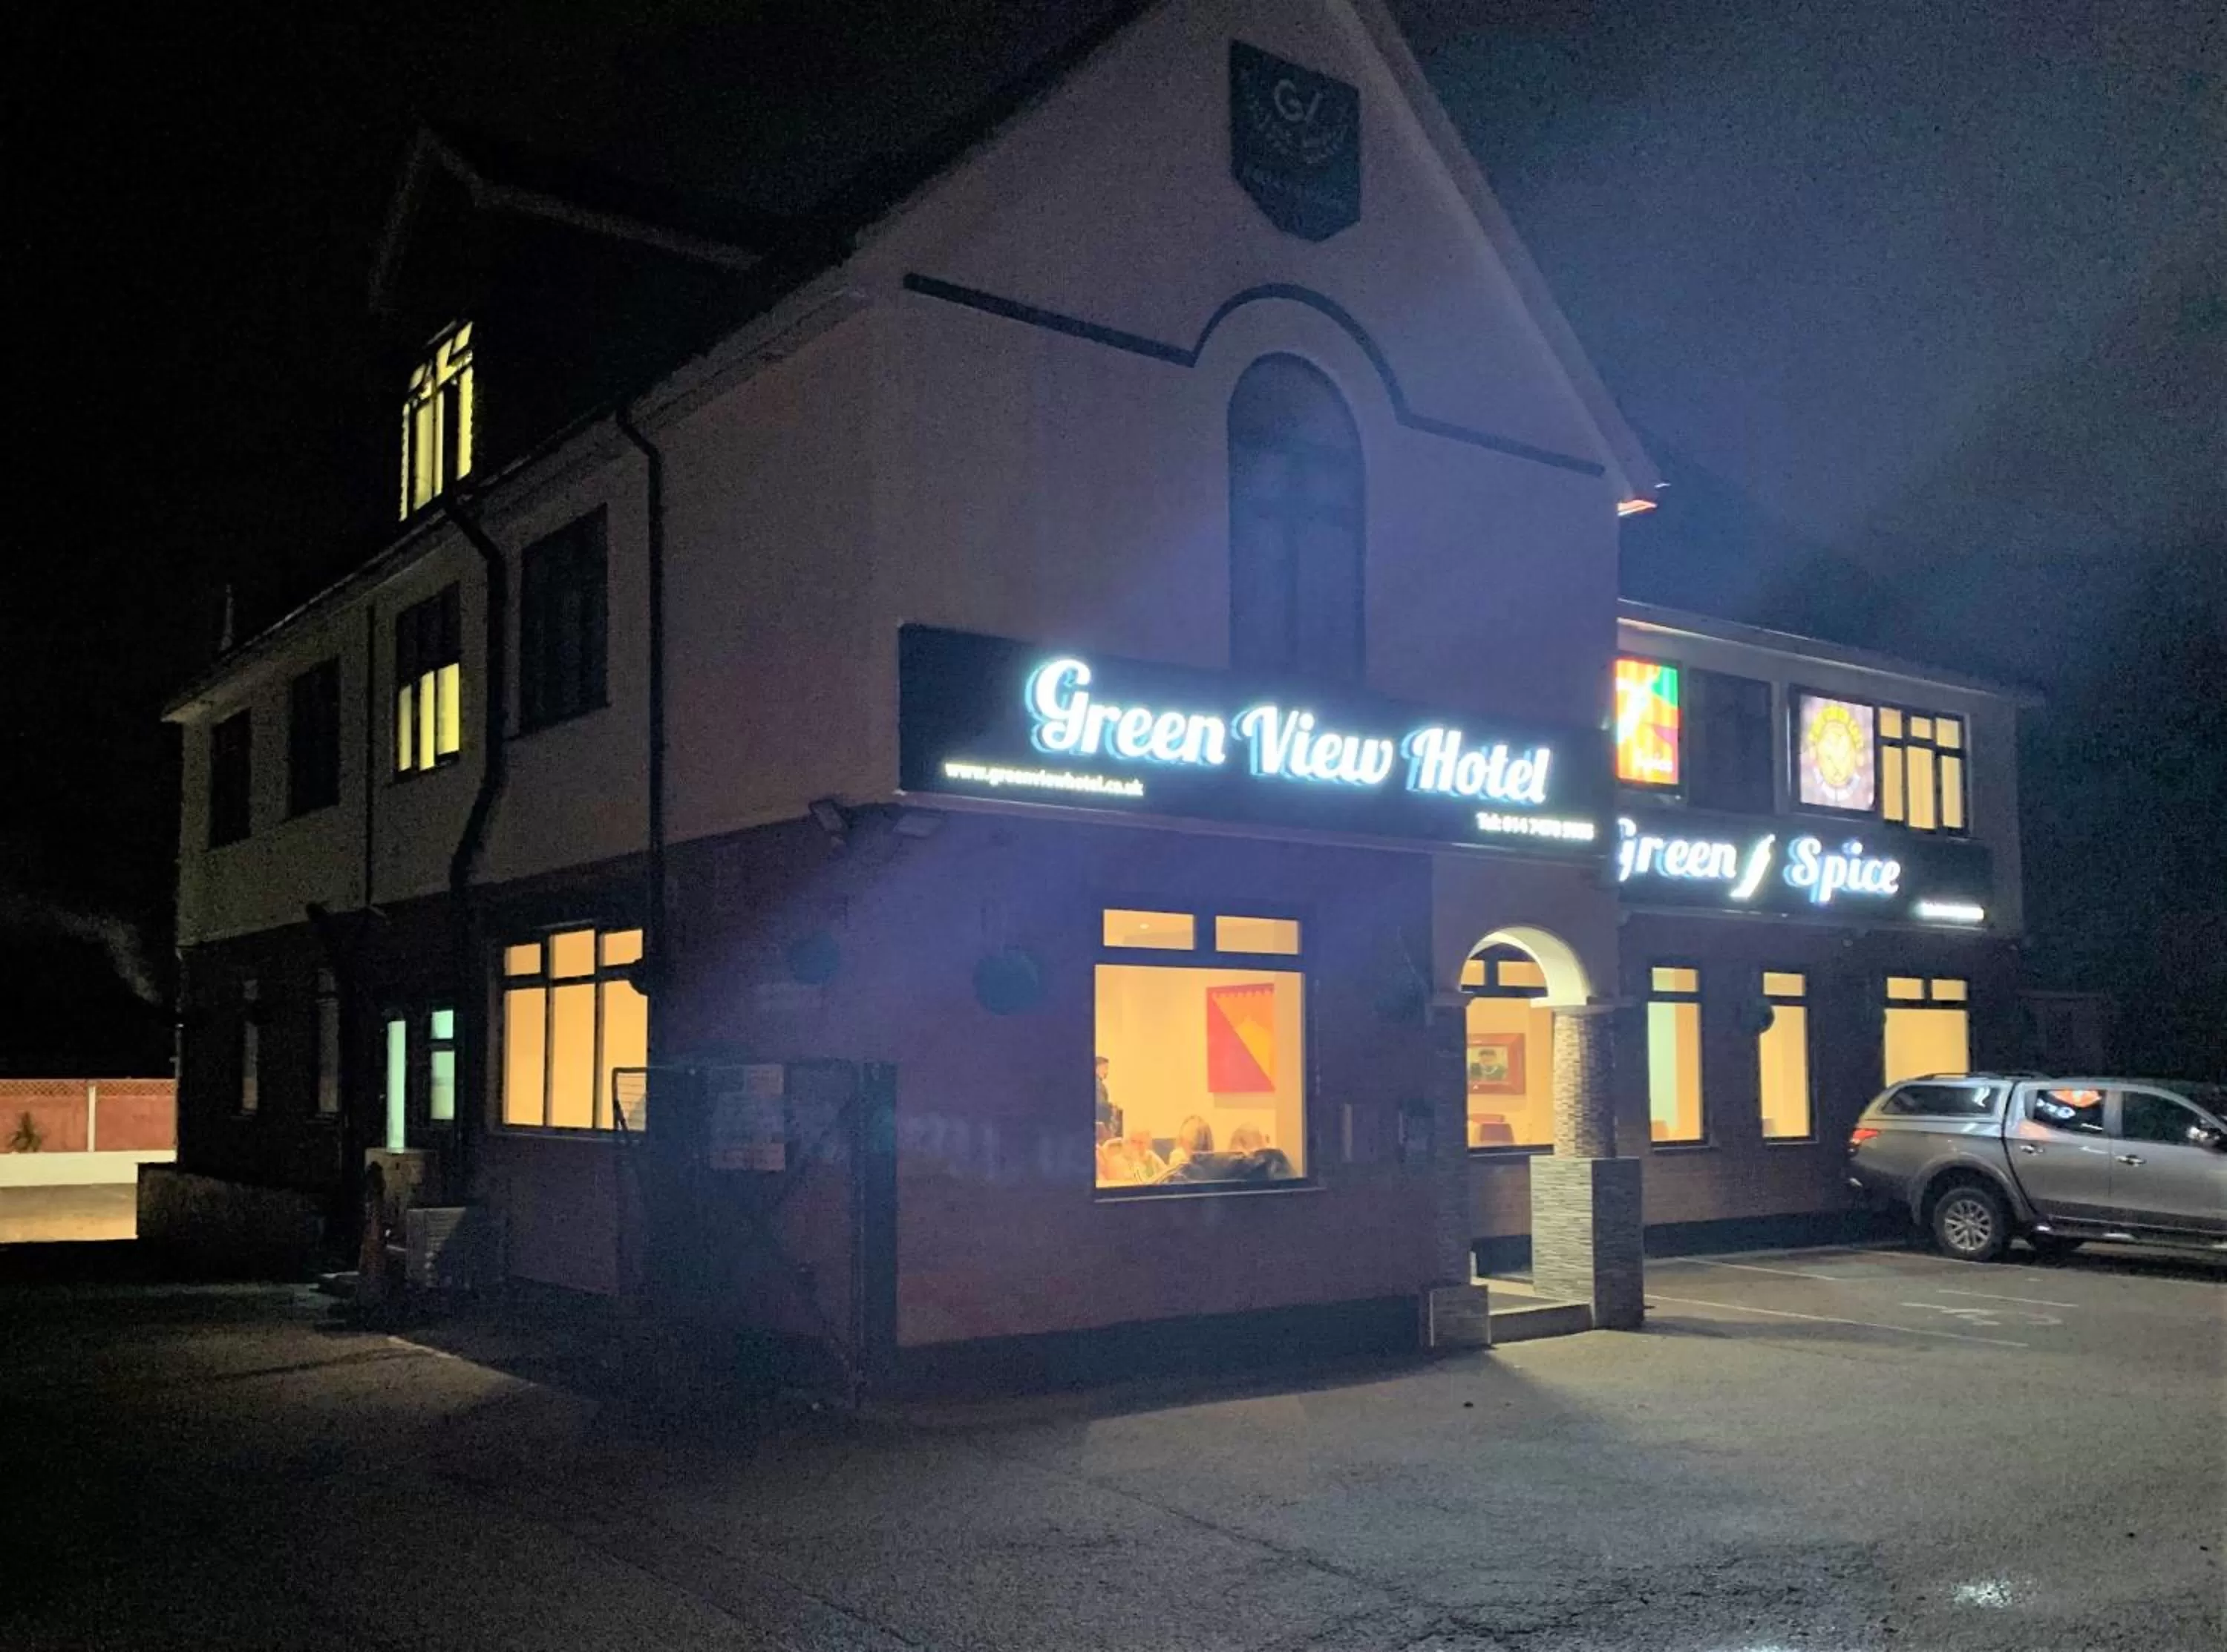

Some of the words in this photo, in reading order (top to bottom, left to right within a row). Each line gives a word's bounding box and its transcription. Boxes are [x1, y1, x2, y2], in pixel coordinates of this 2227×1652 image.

[1027, 659, 1226, 765] Green
[1233, 706, 1393, 783] View
[1403, 723, 1551, 804] Hotel
[1784, 835, 1901, 906] Spice
